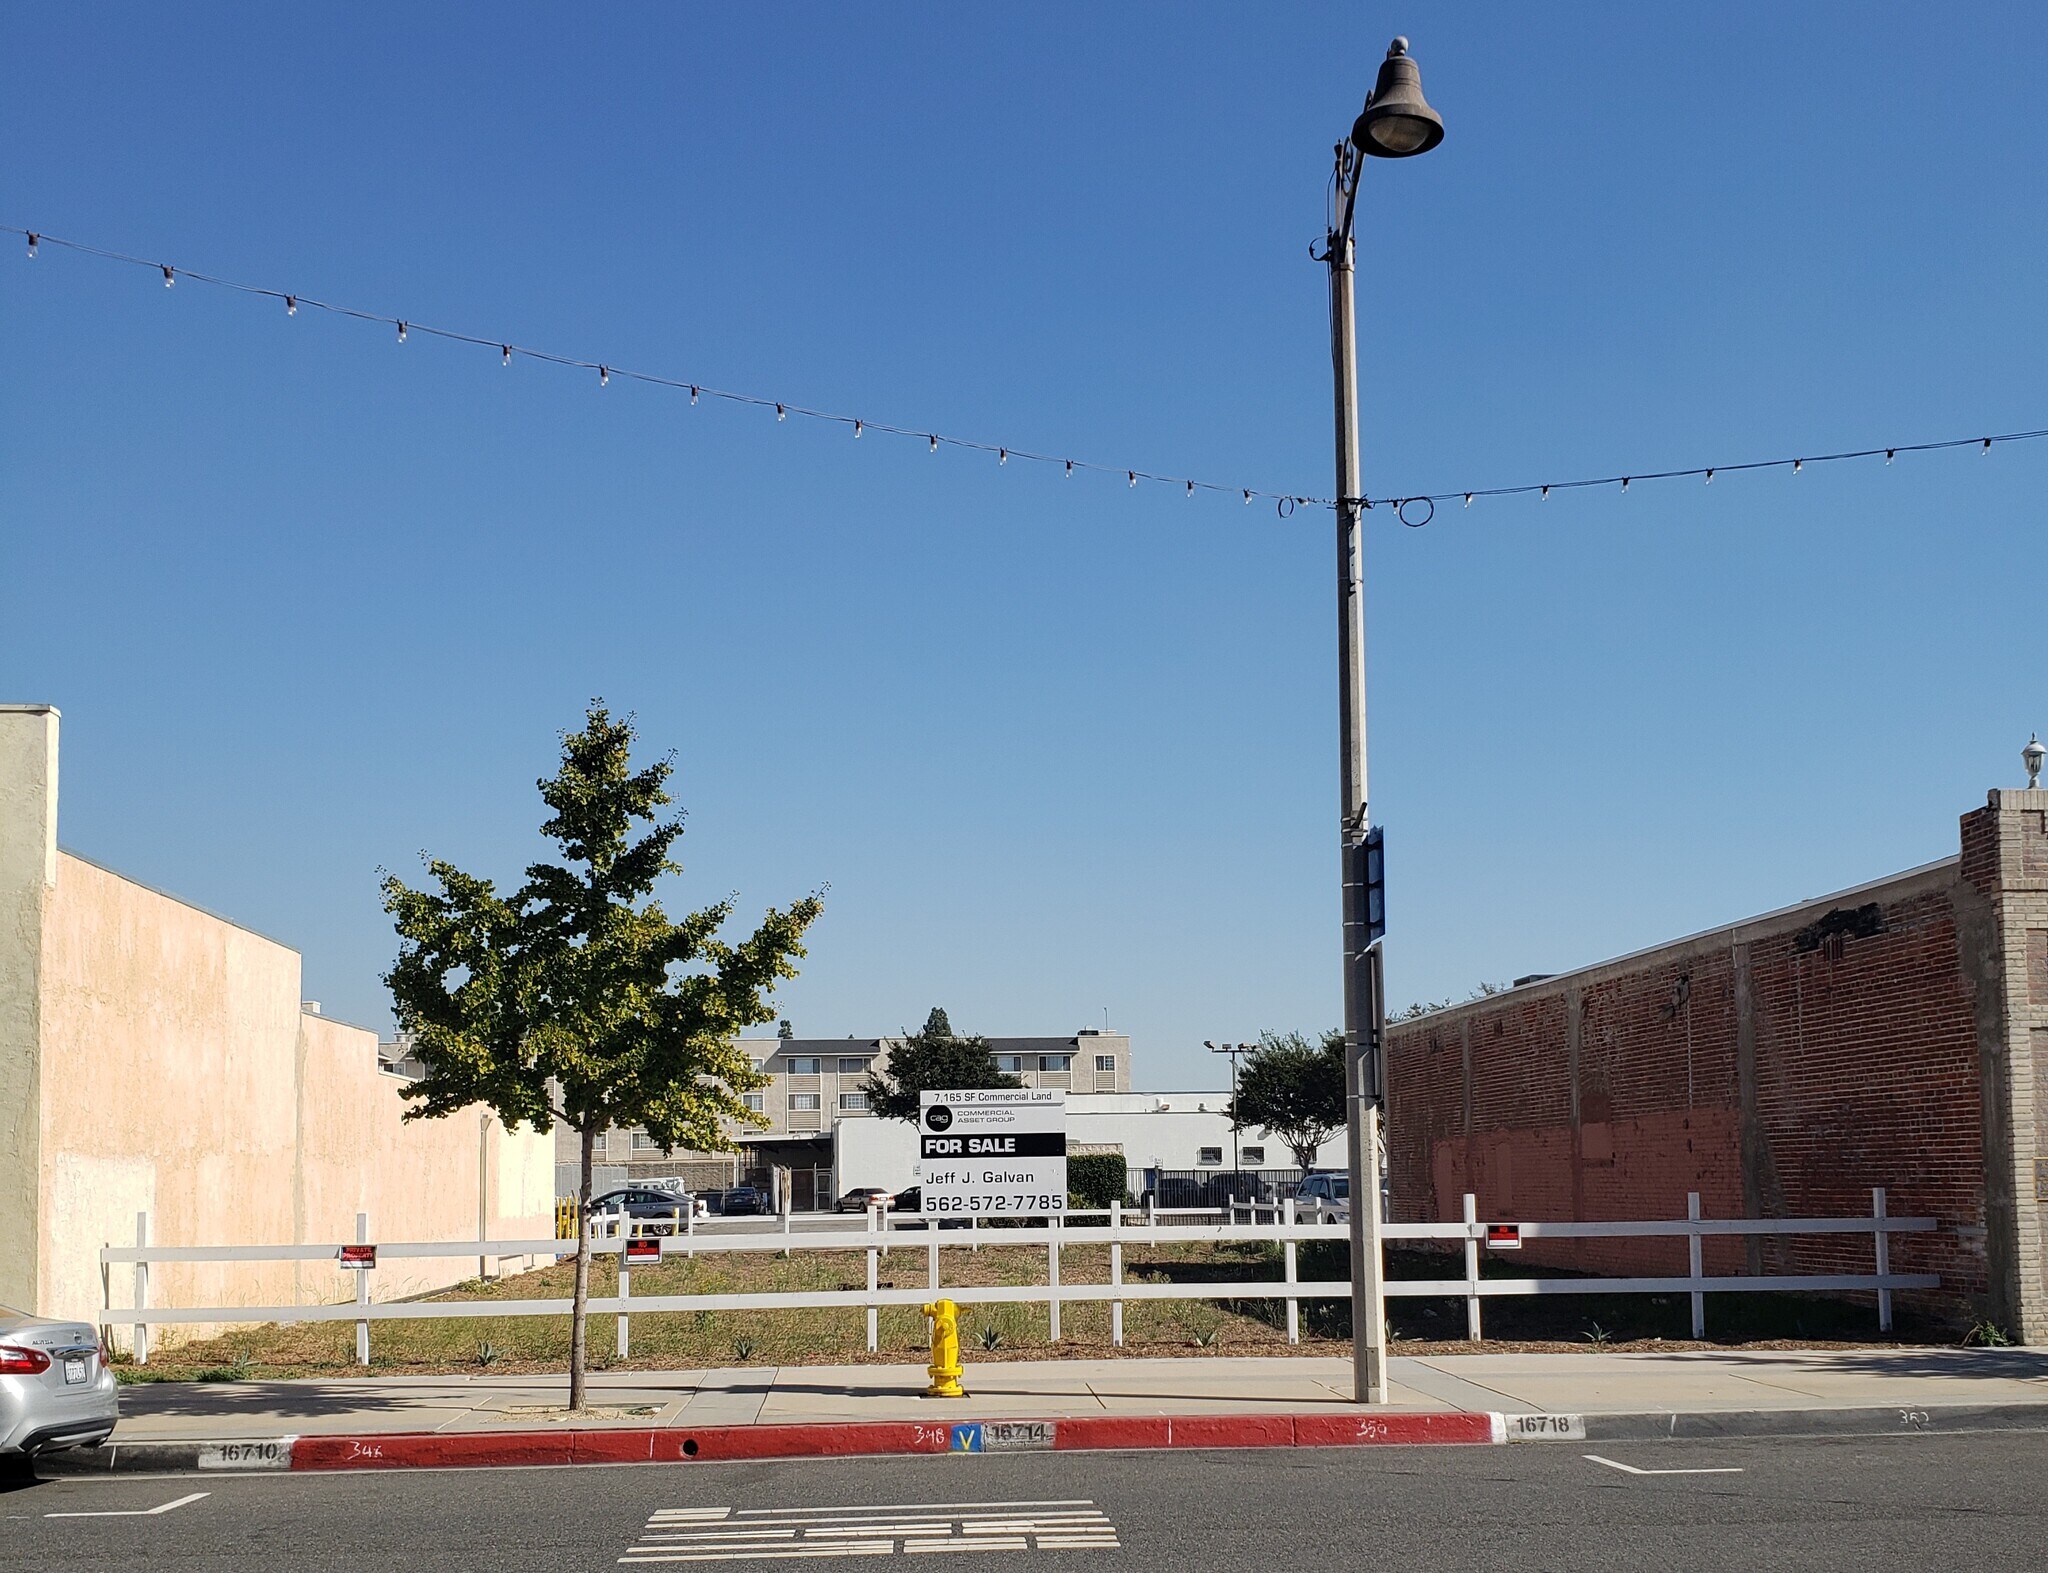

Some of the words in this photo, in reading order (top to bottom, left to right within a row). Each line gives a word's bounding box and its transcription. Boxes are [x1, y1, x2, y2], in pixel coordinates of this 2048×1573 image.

[934, 1093, 962, 1103] 7,165
[964, 1093, 975, 1102] SF
[978, 1092, 1029, 1101] Commercial
[1031, 1092, 1052, 1100] Land
[925, 1139, 962, 1154] FOR
[968, 1138, 1016, 1153] SALE
[926, 1172, 956, 1184] Jeff
[962, 1172, 975, 1184] J.
[982, 1171, 1034, 1183] Galvan
[926, 1195, 1062, 1211] 562-572-7785
[991, 1423, 1045, 1441] 16714
[1516, 1416, 1570, 1433] 16718
[219, 1443, 277, 1461] 16710
